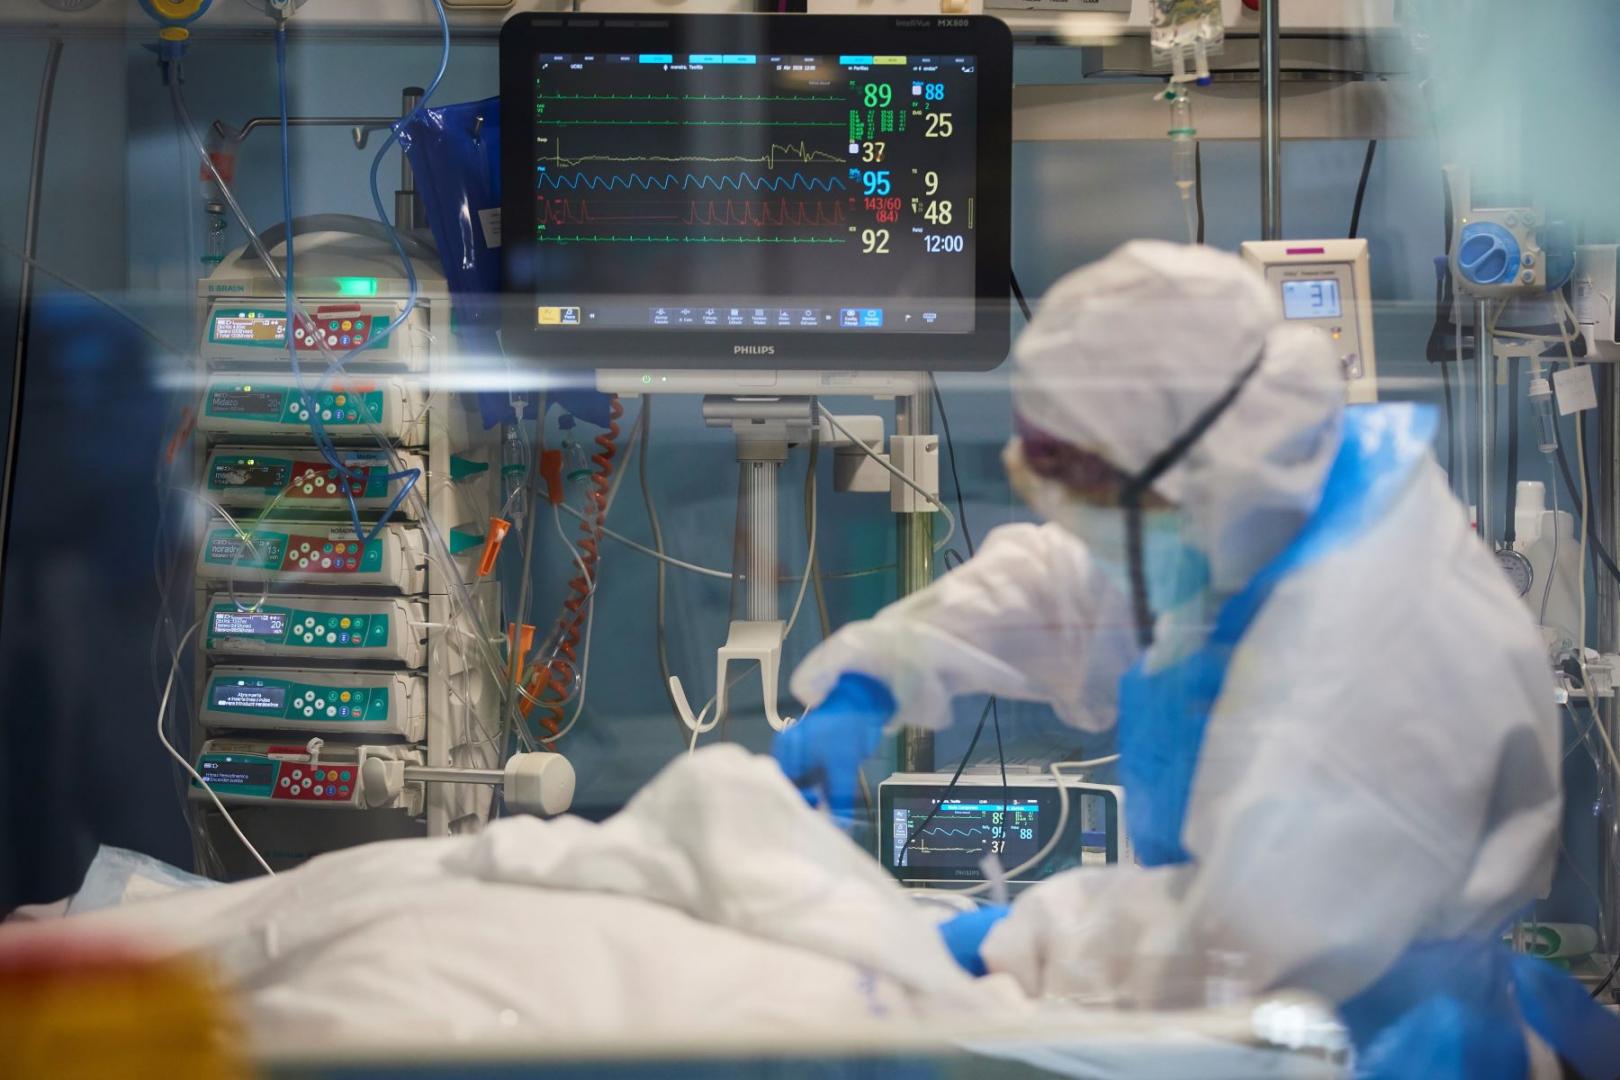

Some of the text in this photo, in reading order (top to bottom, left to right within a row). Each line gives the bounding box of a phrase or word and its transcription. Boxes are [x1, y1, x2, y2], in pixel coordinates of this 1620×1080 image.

[863, 83, 892, 108] 89
[925, 83, 945, 101] 88
[925, 112, 953, 138] 25
[862, 141, 886, 162] 37
[862, 170, 892, 196] 95
[924, 171, 939, 196] 9
[863, 197, 902, 210] 143/60
[923, 200, 953, 225] 48
[876, 210, 899, 223] (84)
[861, 229, 890, 254] 92
[924, 235, 964, 252] 12:00
[733, 345, 776, 355] PHILIPS
[270, 620, 281, 629] 20
[1020, 828, 1033, 840] 88
